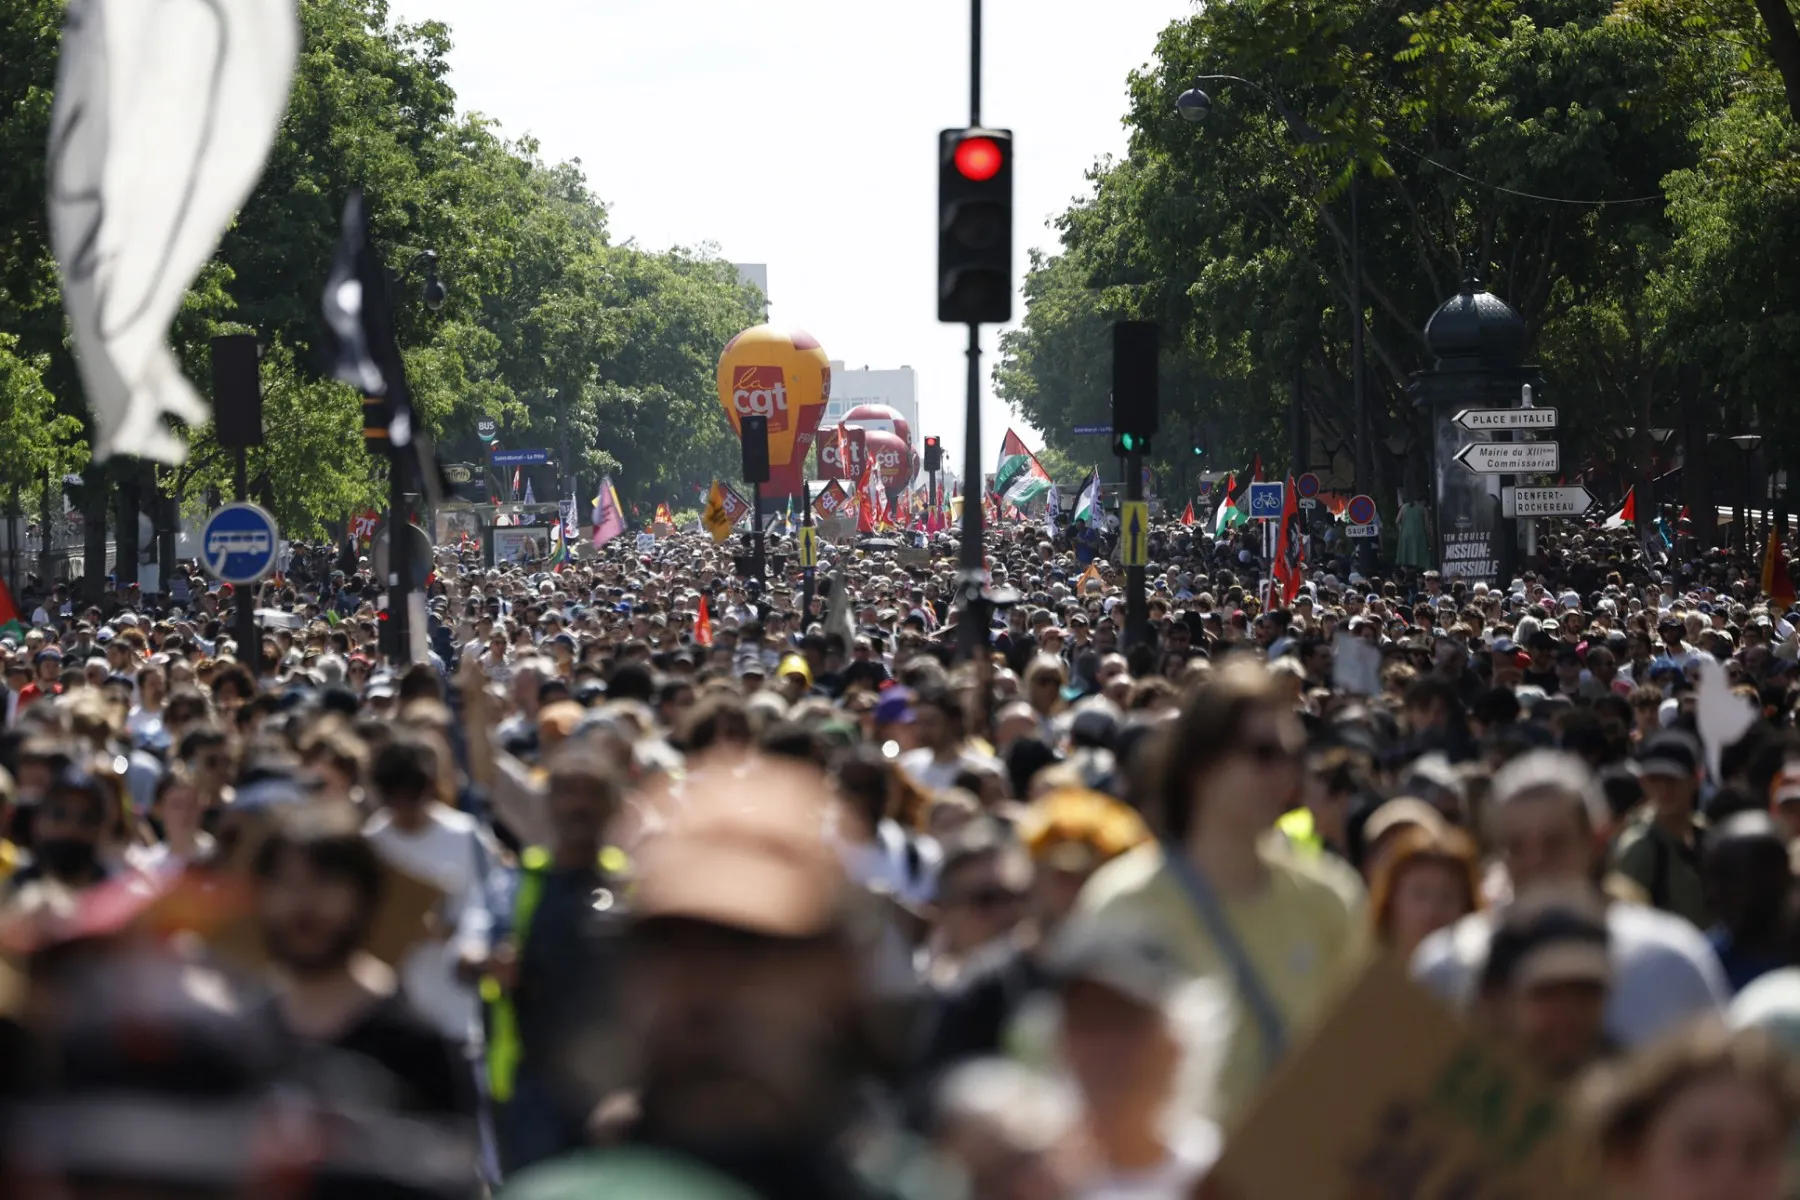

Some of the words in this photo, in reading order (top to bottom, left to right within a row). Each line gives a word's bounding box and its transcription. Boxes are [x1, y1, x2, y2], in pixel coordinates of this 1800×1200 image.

[734, 367, 775, 389] la
[734, 382, 788, 419] cgt
[1473, 416, 1506, 424] PLACE
[1510, 414, 1553, 424] ITALIE
[478, 421, 494, 430] BUS
[1480, 448, 1508, 456] Mairie
[1512, 448, 1523, 456] du
[876, 451, 899, 467] cgt
[1487, 459, 1555, 468] Commissariat
[1517, 492, 1563, 500] DENFERT-
[822, 491, 838, 512] cgt
[1518, 502, 1574, 511] ROCHEREAU
[1347, 527, 1366, 535] SAUF
[1443, 533, 1455, 542] TOM
[1458, 532, 1491, 541] CRUISE
[1446, 542, 1491, 559] MISSION:
